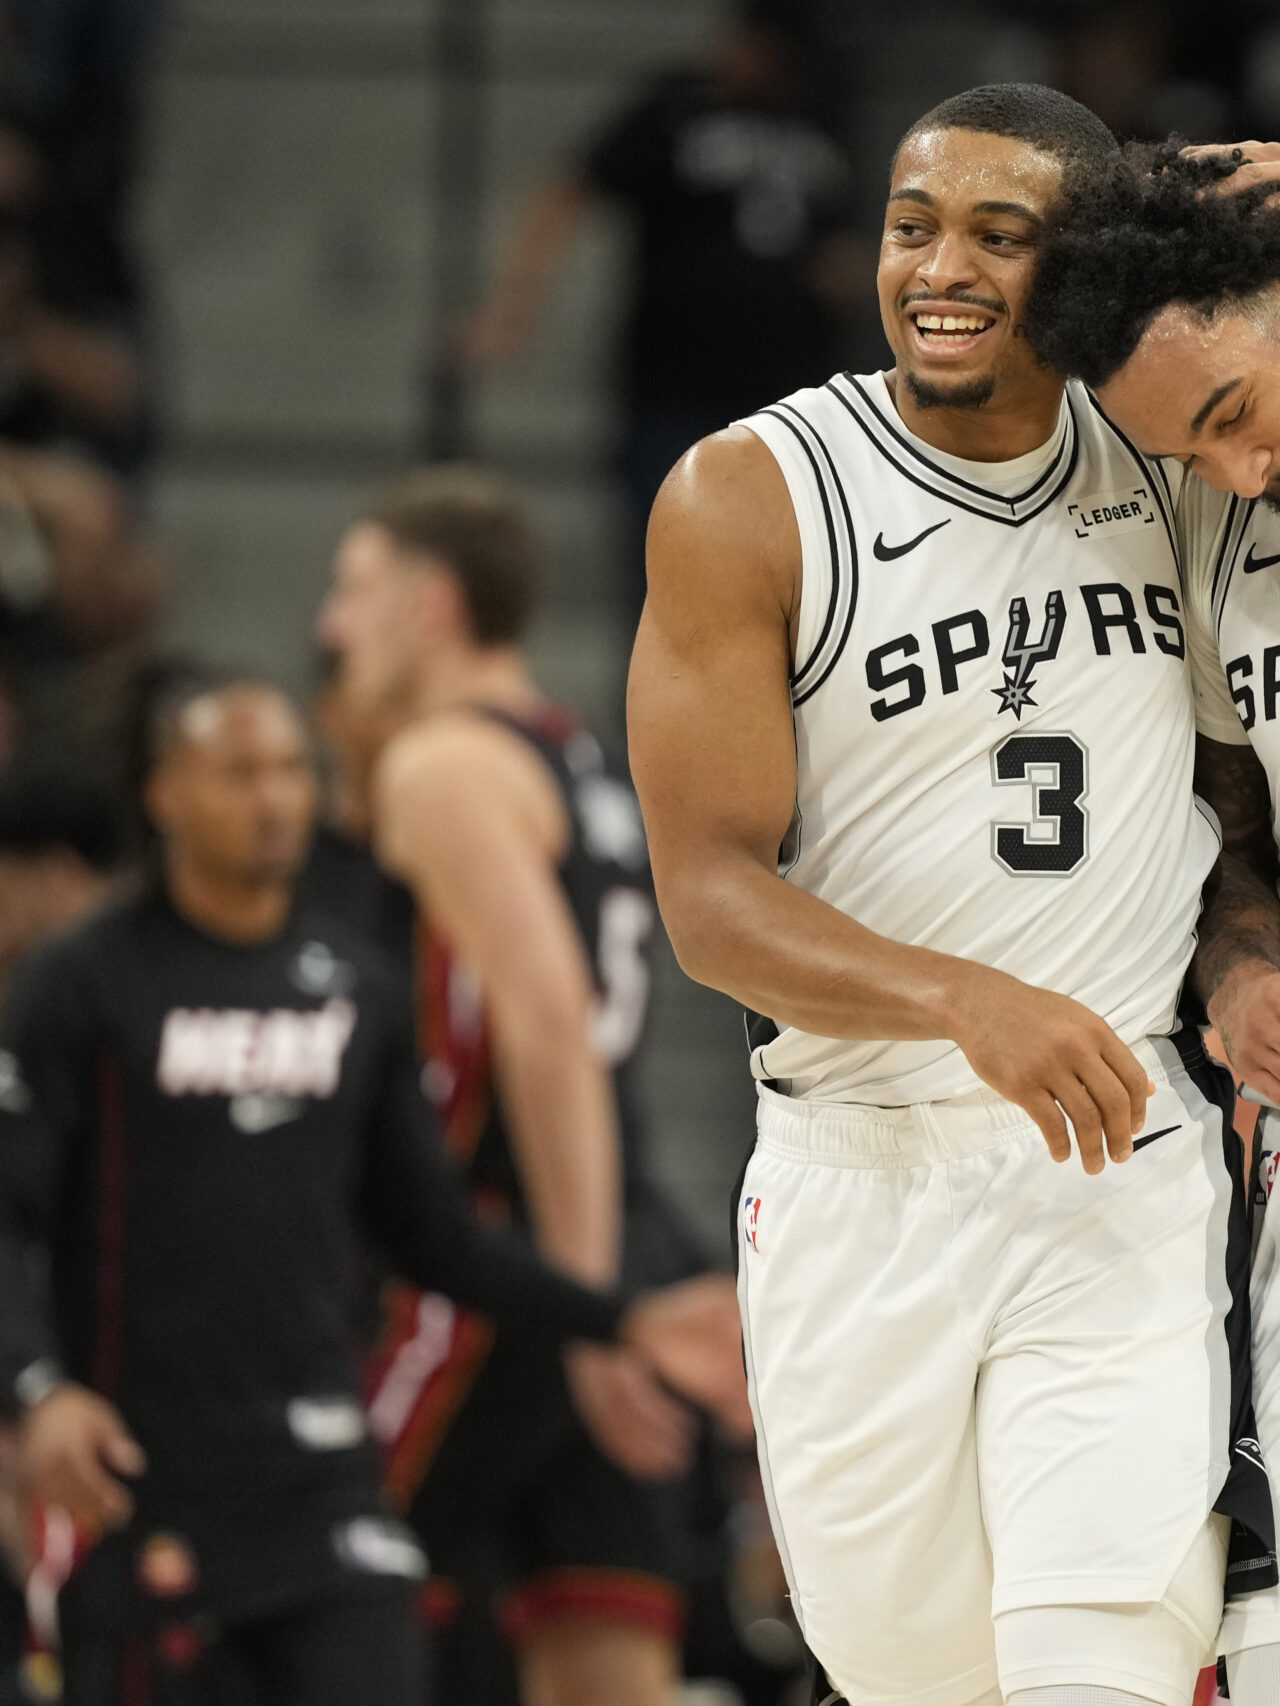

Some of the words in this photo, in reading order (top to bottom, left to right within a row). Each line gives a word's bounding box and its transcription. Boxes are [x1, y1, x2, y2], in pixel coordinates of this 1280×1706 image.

[1080, 501, 1142, 527] LEDGER
[865, 582, 1185, 722] SPURS
[989, 729, 1090, 878] 3
